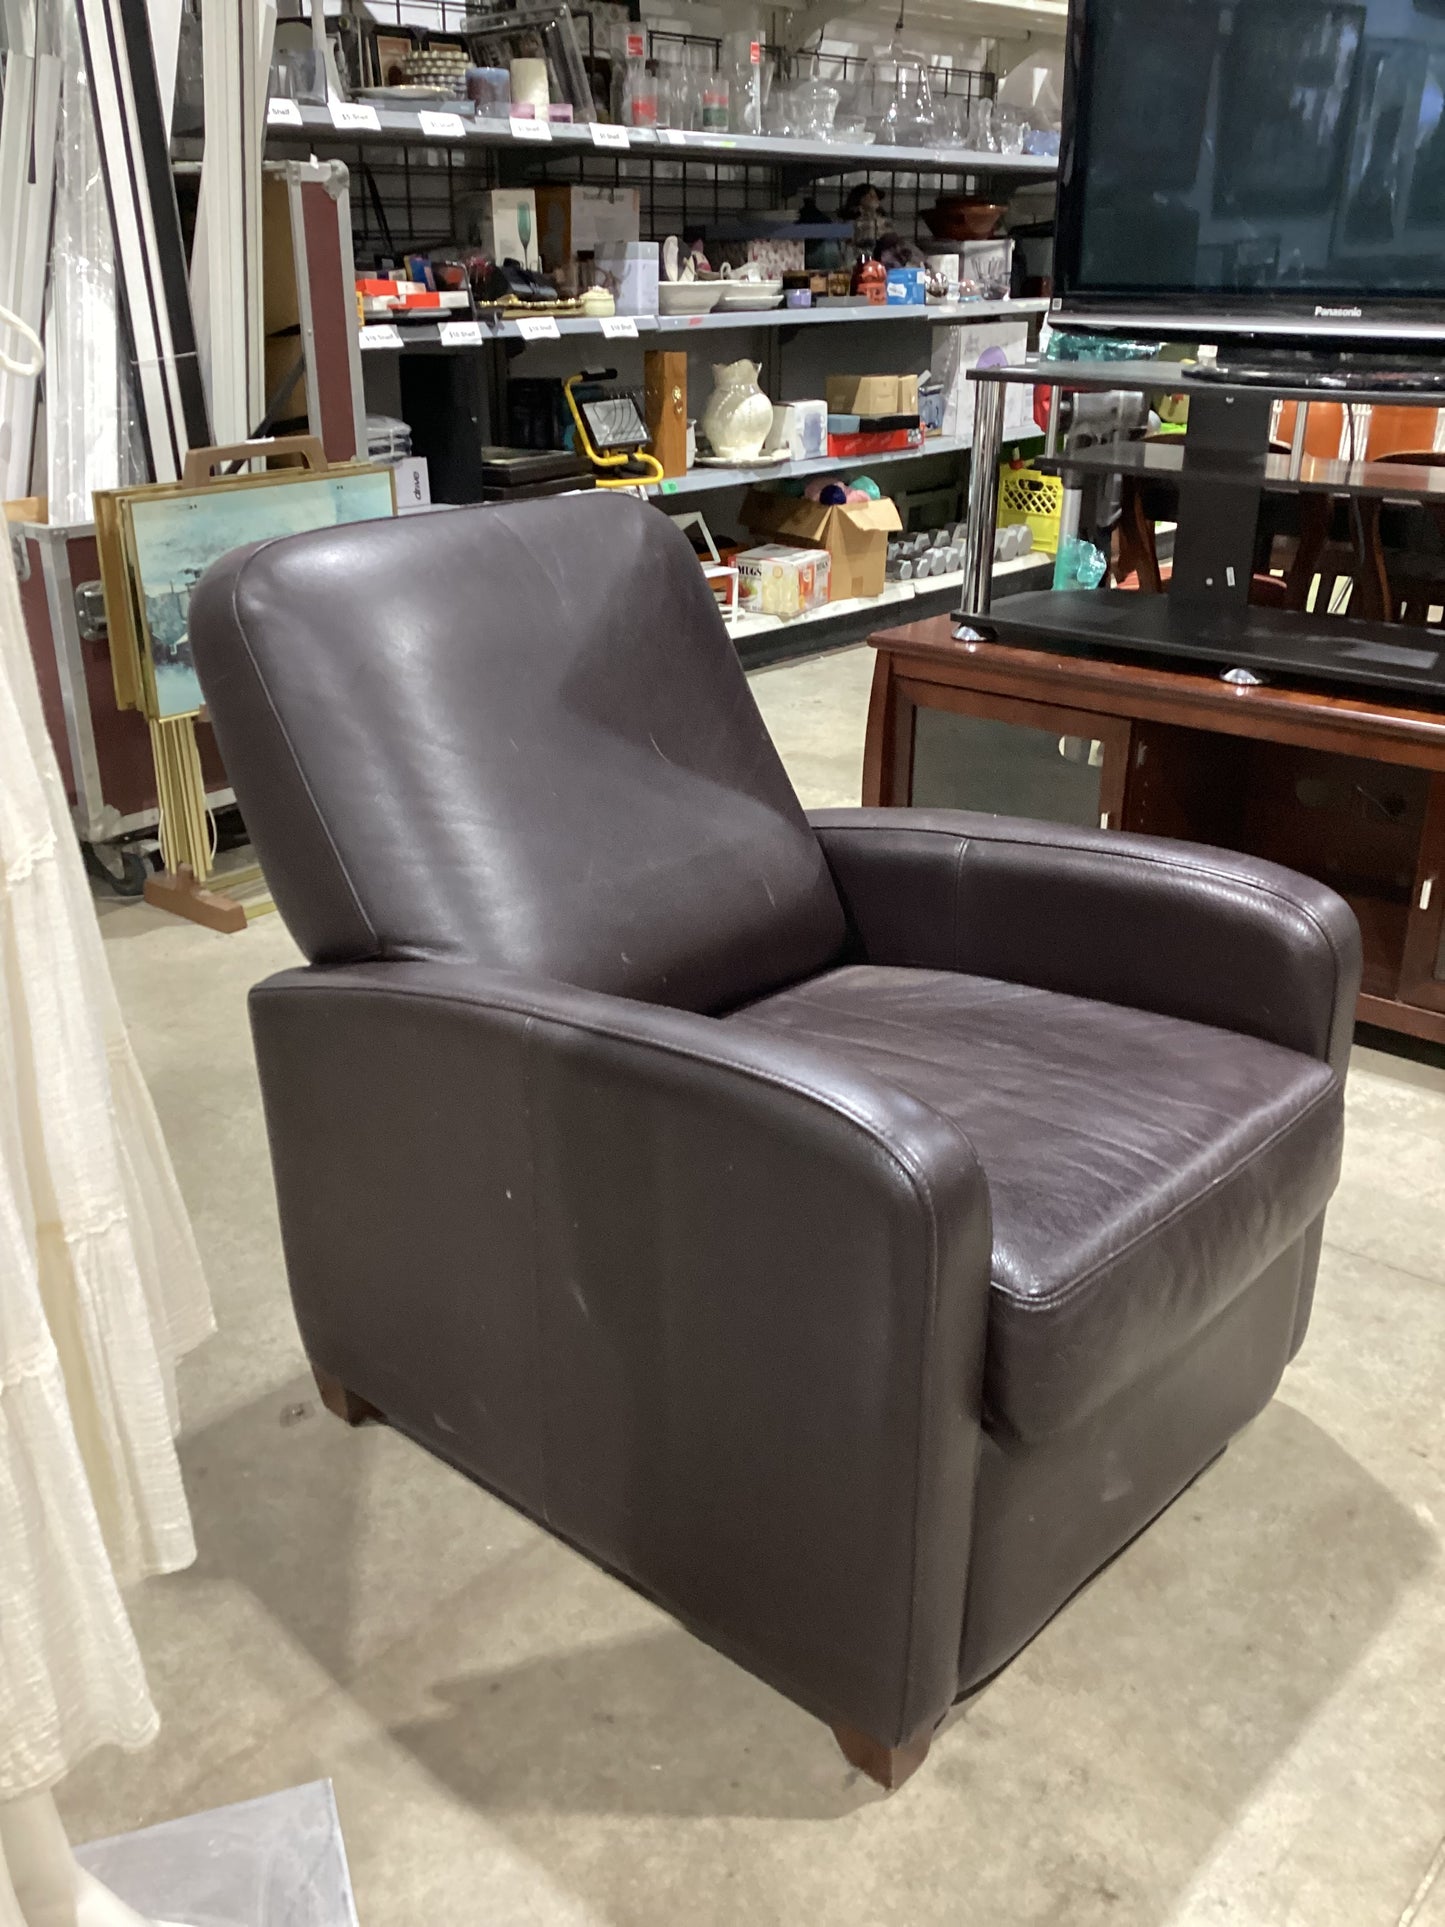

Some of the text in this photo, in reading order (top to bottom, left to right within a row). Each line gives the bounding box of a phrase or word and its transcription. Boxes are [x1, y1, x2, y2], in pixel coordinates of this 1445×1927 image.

[1314, 305, 1362, 317] Panasonic
[413, 471, 421, 500] drive
[738, 565, 762, 577] MUGS
